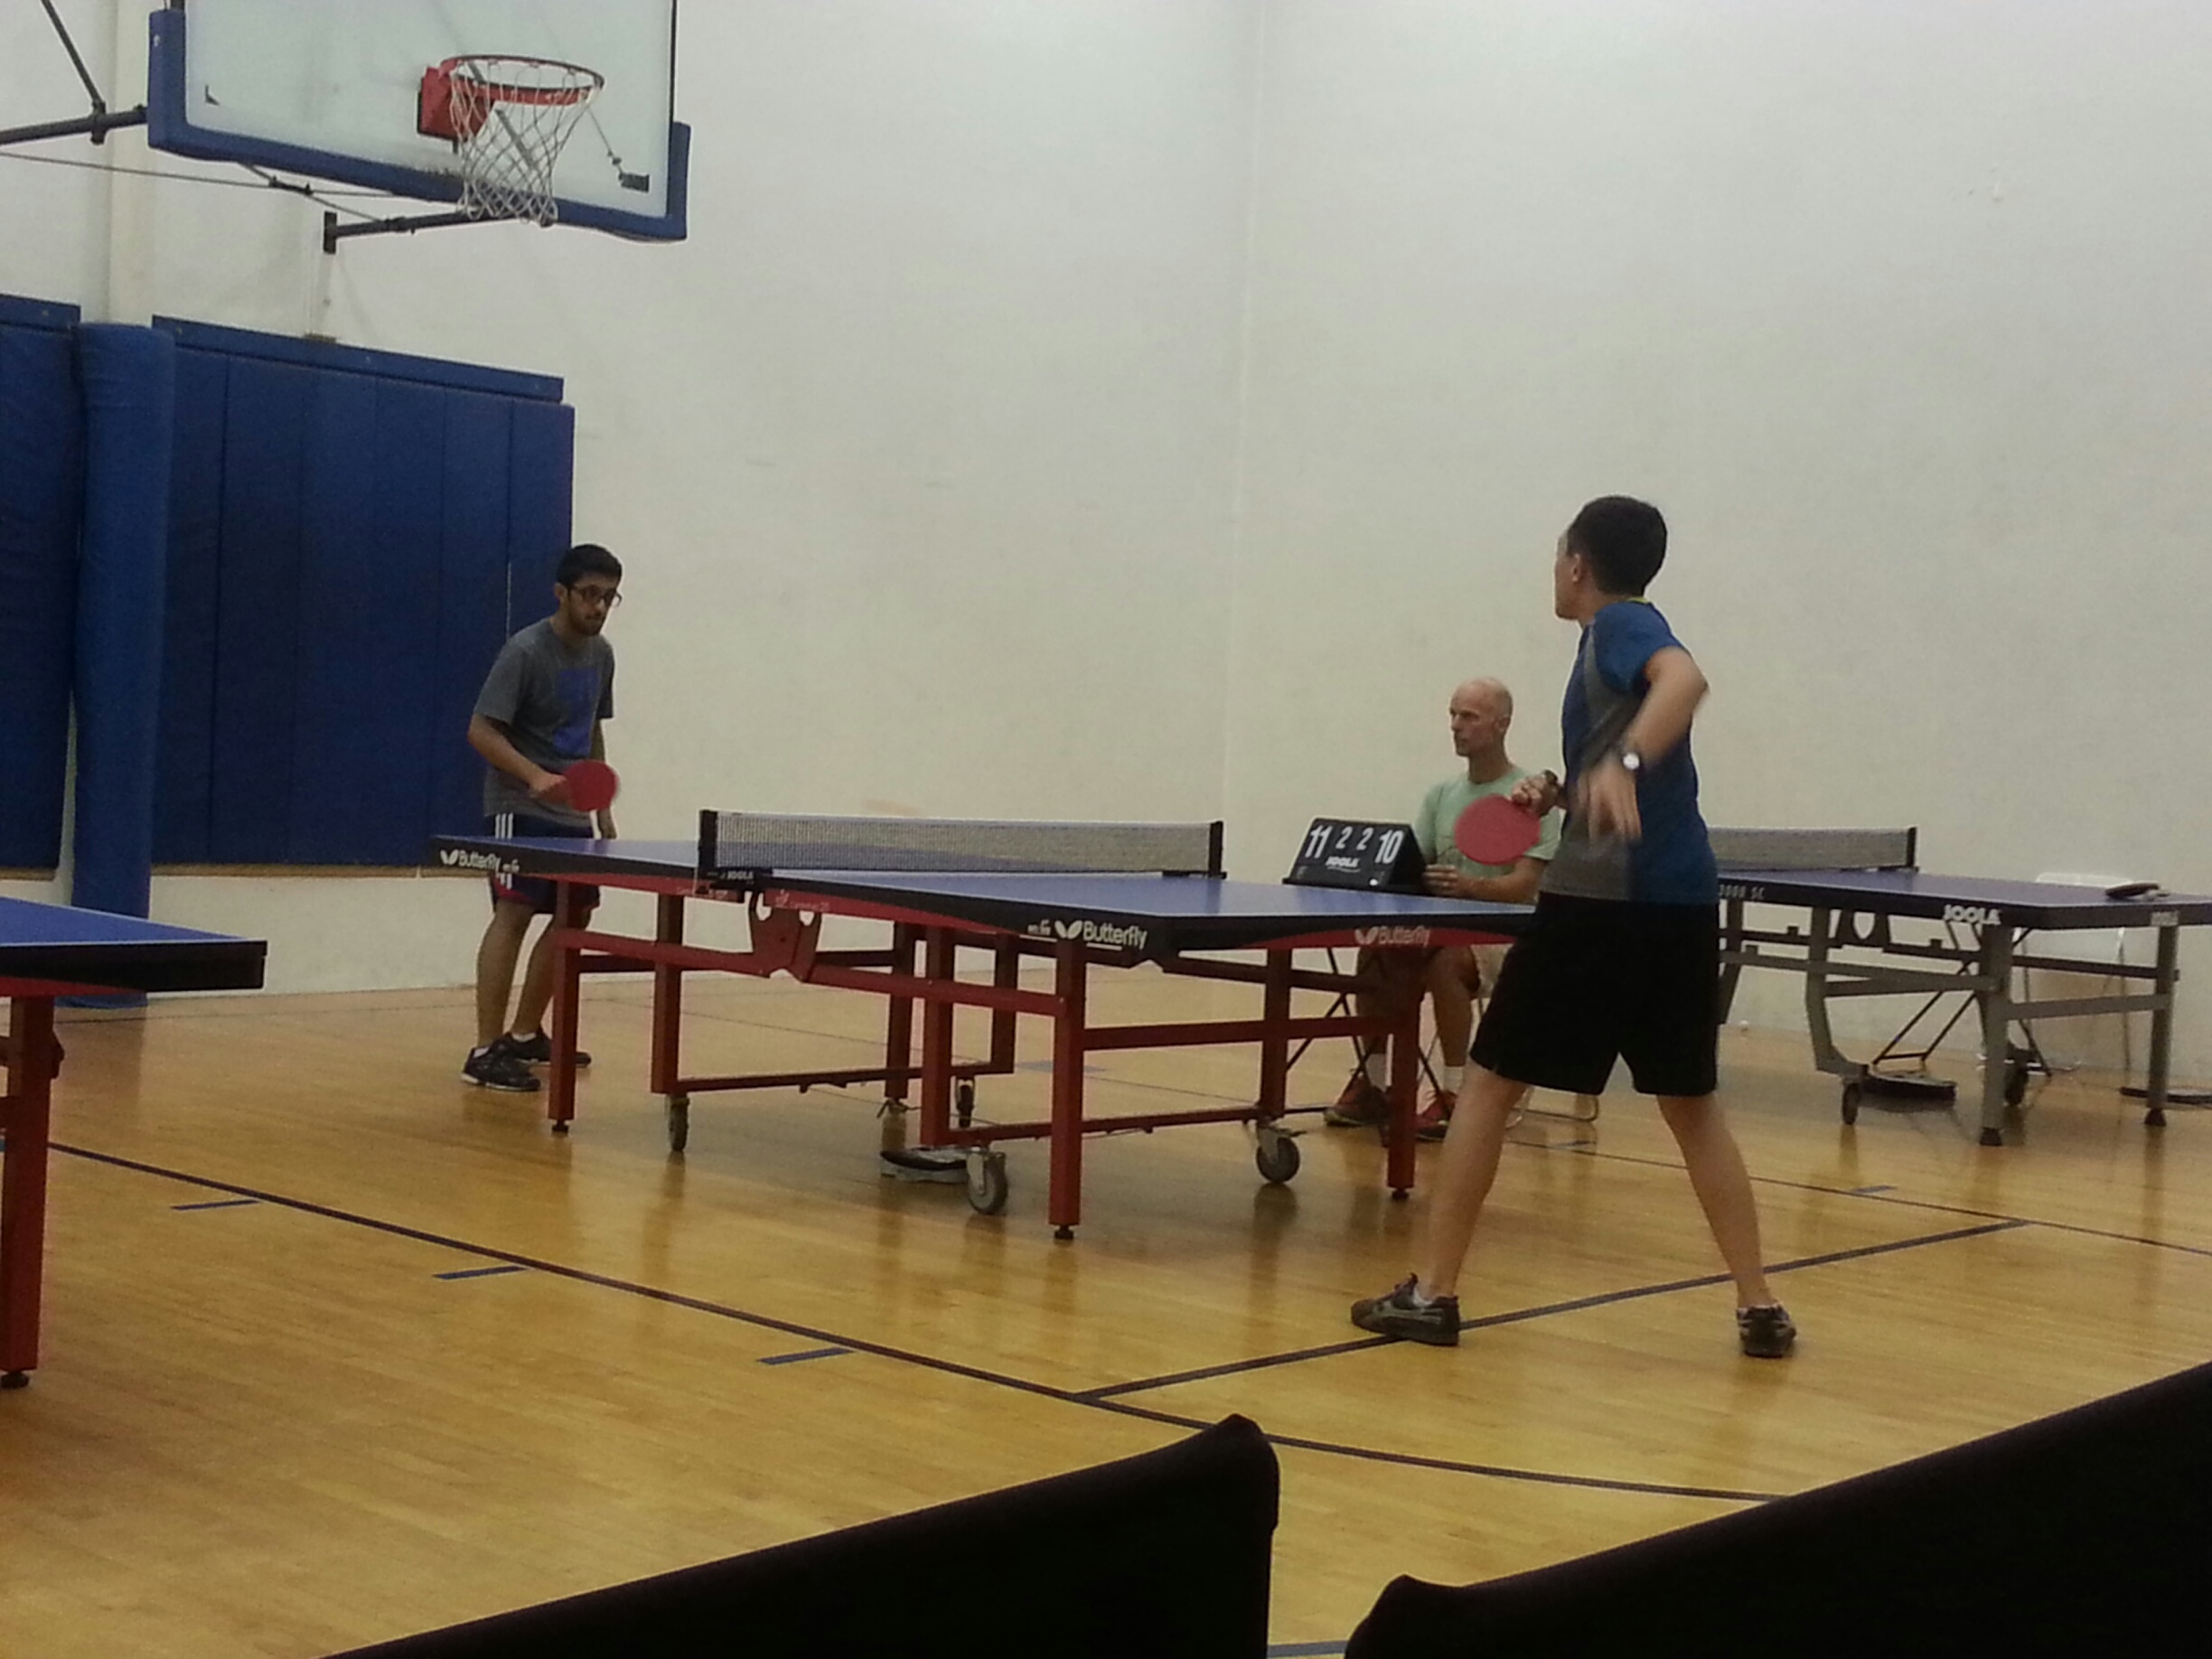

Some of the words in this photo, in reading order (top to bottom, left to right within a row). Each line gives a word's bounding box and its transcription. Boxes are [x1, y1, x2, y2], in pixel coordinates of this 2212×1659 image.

[1305, 824, 1333, 858] 11
[1335, 826, 1354, 849] 2
[1355, 827, 1374, 851] 2
[1374, 830, 1404, 865] 10
[458, 849, 501, 876] Butterfly
[1943, 904, 2002, 925] JOOLA
[1083, 920, 1148, 950] Butterfly
[1378, 924, 1431, 948] Butterfly
